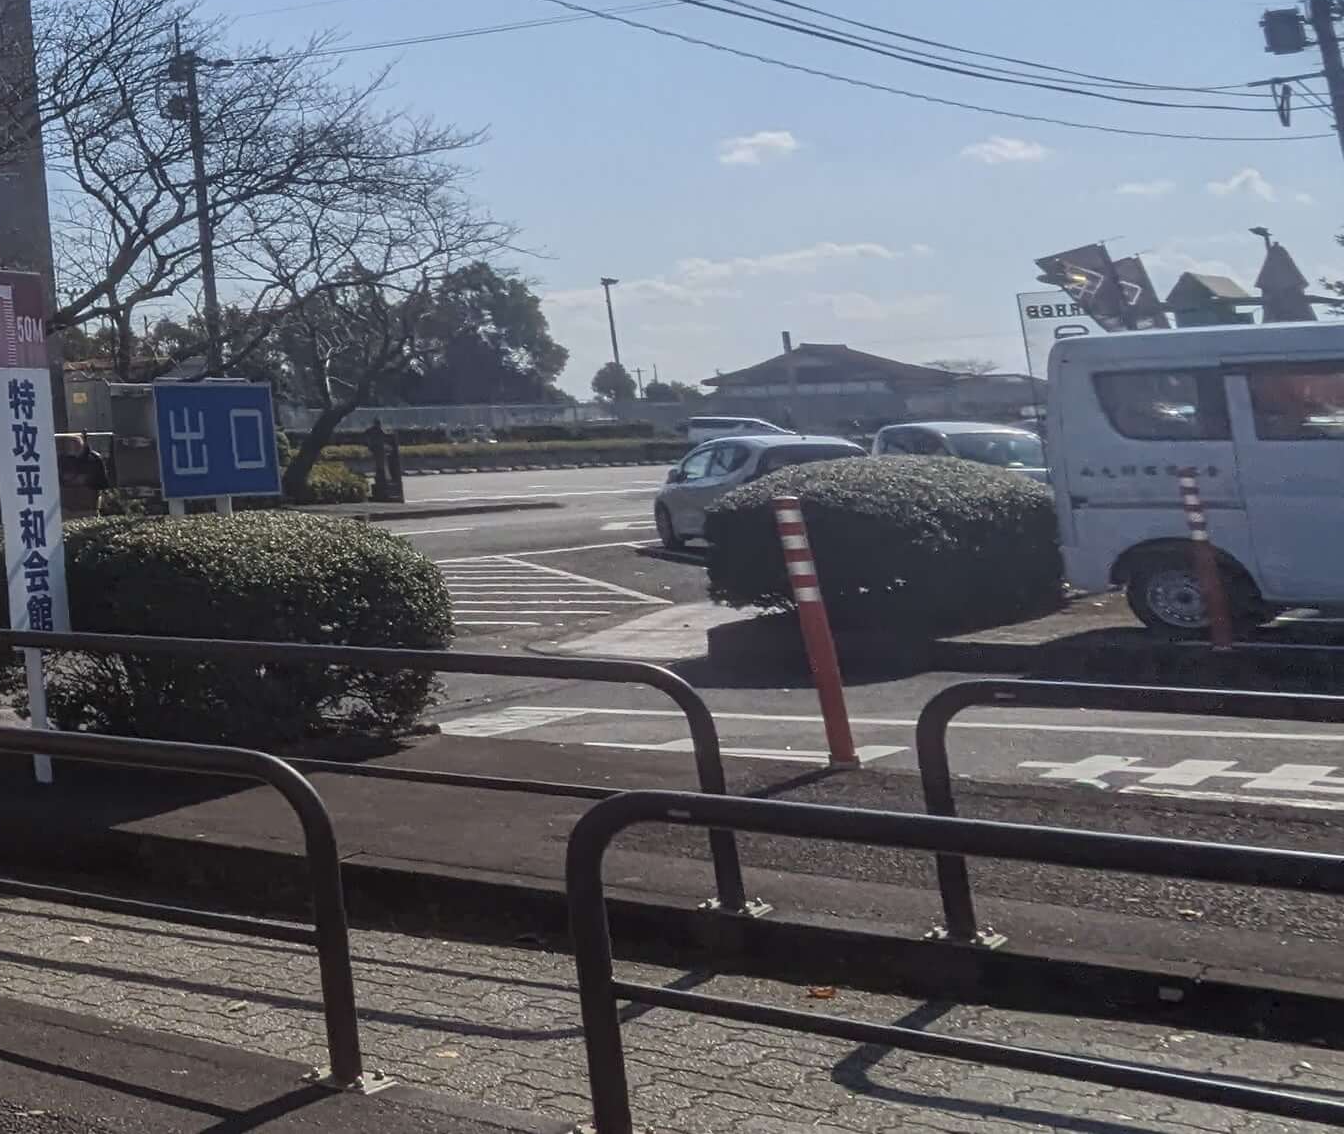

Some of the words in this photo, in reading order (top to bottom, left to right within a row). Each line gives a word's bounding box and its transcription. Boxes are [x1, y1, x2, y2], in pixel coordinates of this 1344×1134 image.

[16, 315, 44, 343] 50M
[170, 407, 266, 476] 出口
[7, 378, 54, 632] 特攻平和会館
